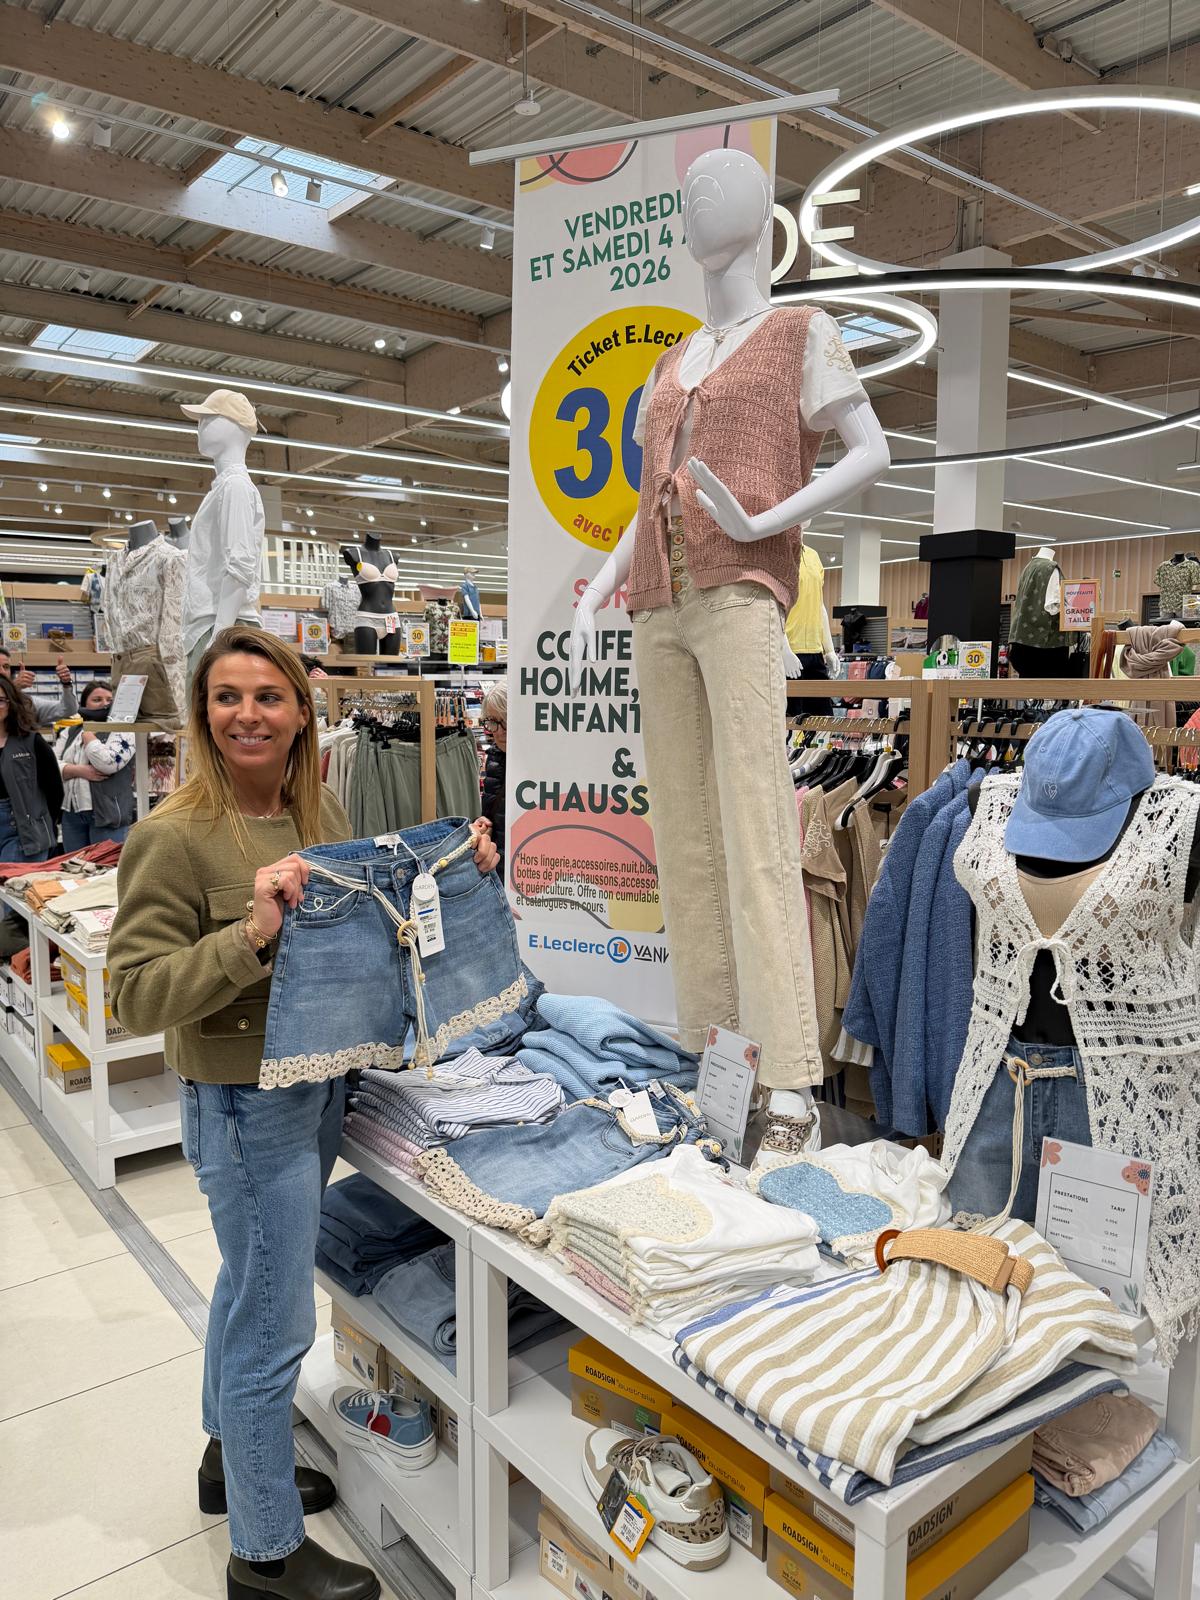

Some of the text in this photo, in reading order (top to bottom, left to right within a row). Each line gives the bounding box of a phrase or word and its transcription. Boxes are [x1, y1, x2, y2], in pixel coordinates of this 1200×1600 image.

[564, 189, 682, 241] VENDREDI
[530, 224, 673, 282] ET SAMEDI 4
[610, 255, 670, 291] 2026
[567, 330, 621, 377] Ticket
[573, 514, 612, 542] avec
[612, 747, 636, 778] &
[515, 780, 649, 816] CHAUSS
[517, 866, 540, 880] bottes
[543, 868, 552, 880] de
[526, 882, 575, 897] puériculture.
[577, 884, 596, 898] Offre
[599, 890, 614, 900] non
[616, 891, 660, 903] cumulable
[526, 897, 568, 911] catalogues
[528, 934, 605, 955] E.Leclerc
